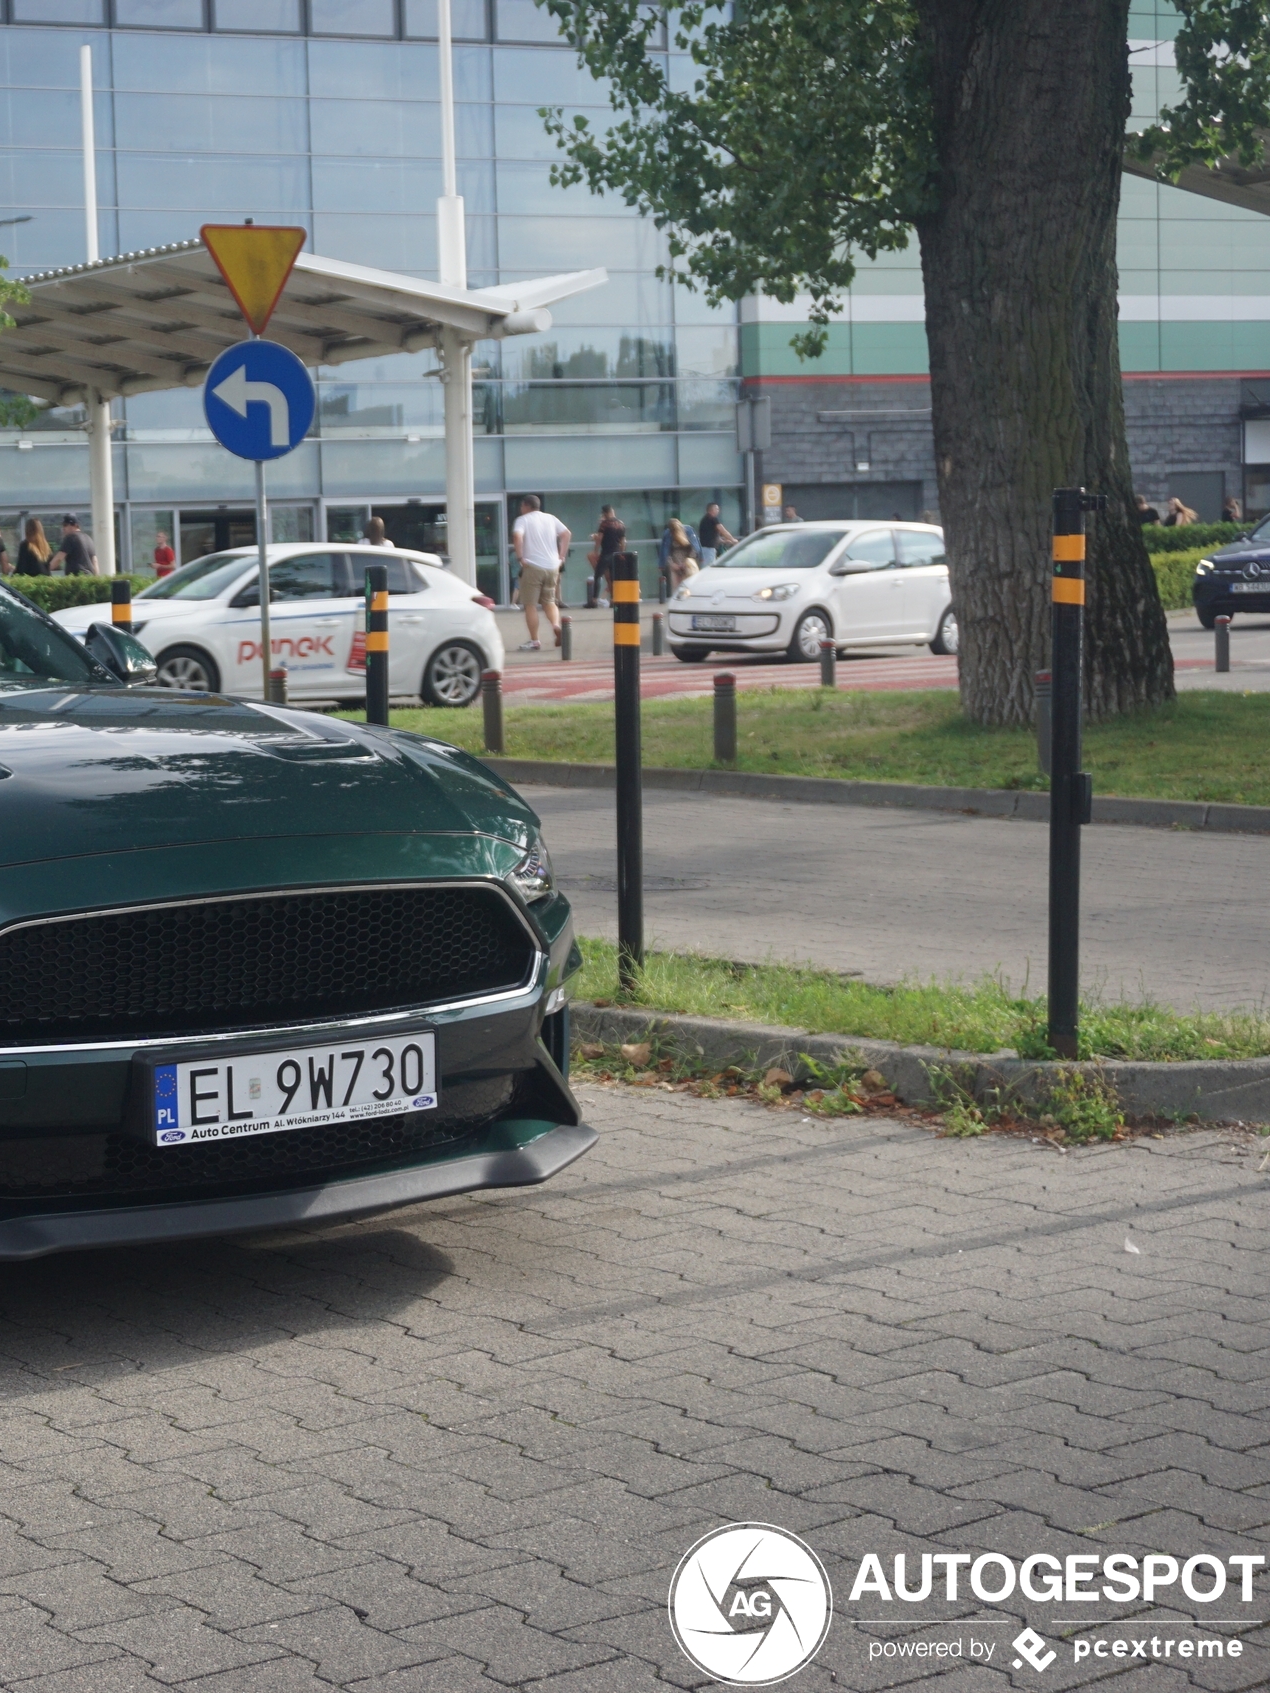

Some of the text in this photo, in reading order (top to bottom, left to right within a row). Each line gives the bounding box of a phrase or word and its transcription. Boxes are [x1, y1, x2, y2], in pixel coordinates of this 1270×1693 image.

[189, 1043, 424, 1126] EL 9W730
[157, 1108, 176, 1125] PL
[191, 1111, 346, 1139] Auto Centrum Al. Włókniarzy 144
[163, 1132, 184, 1142] Ford
